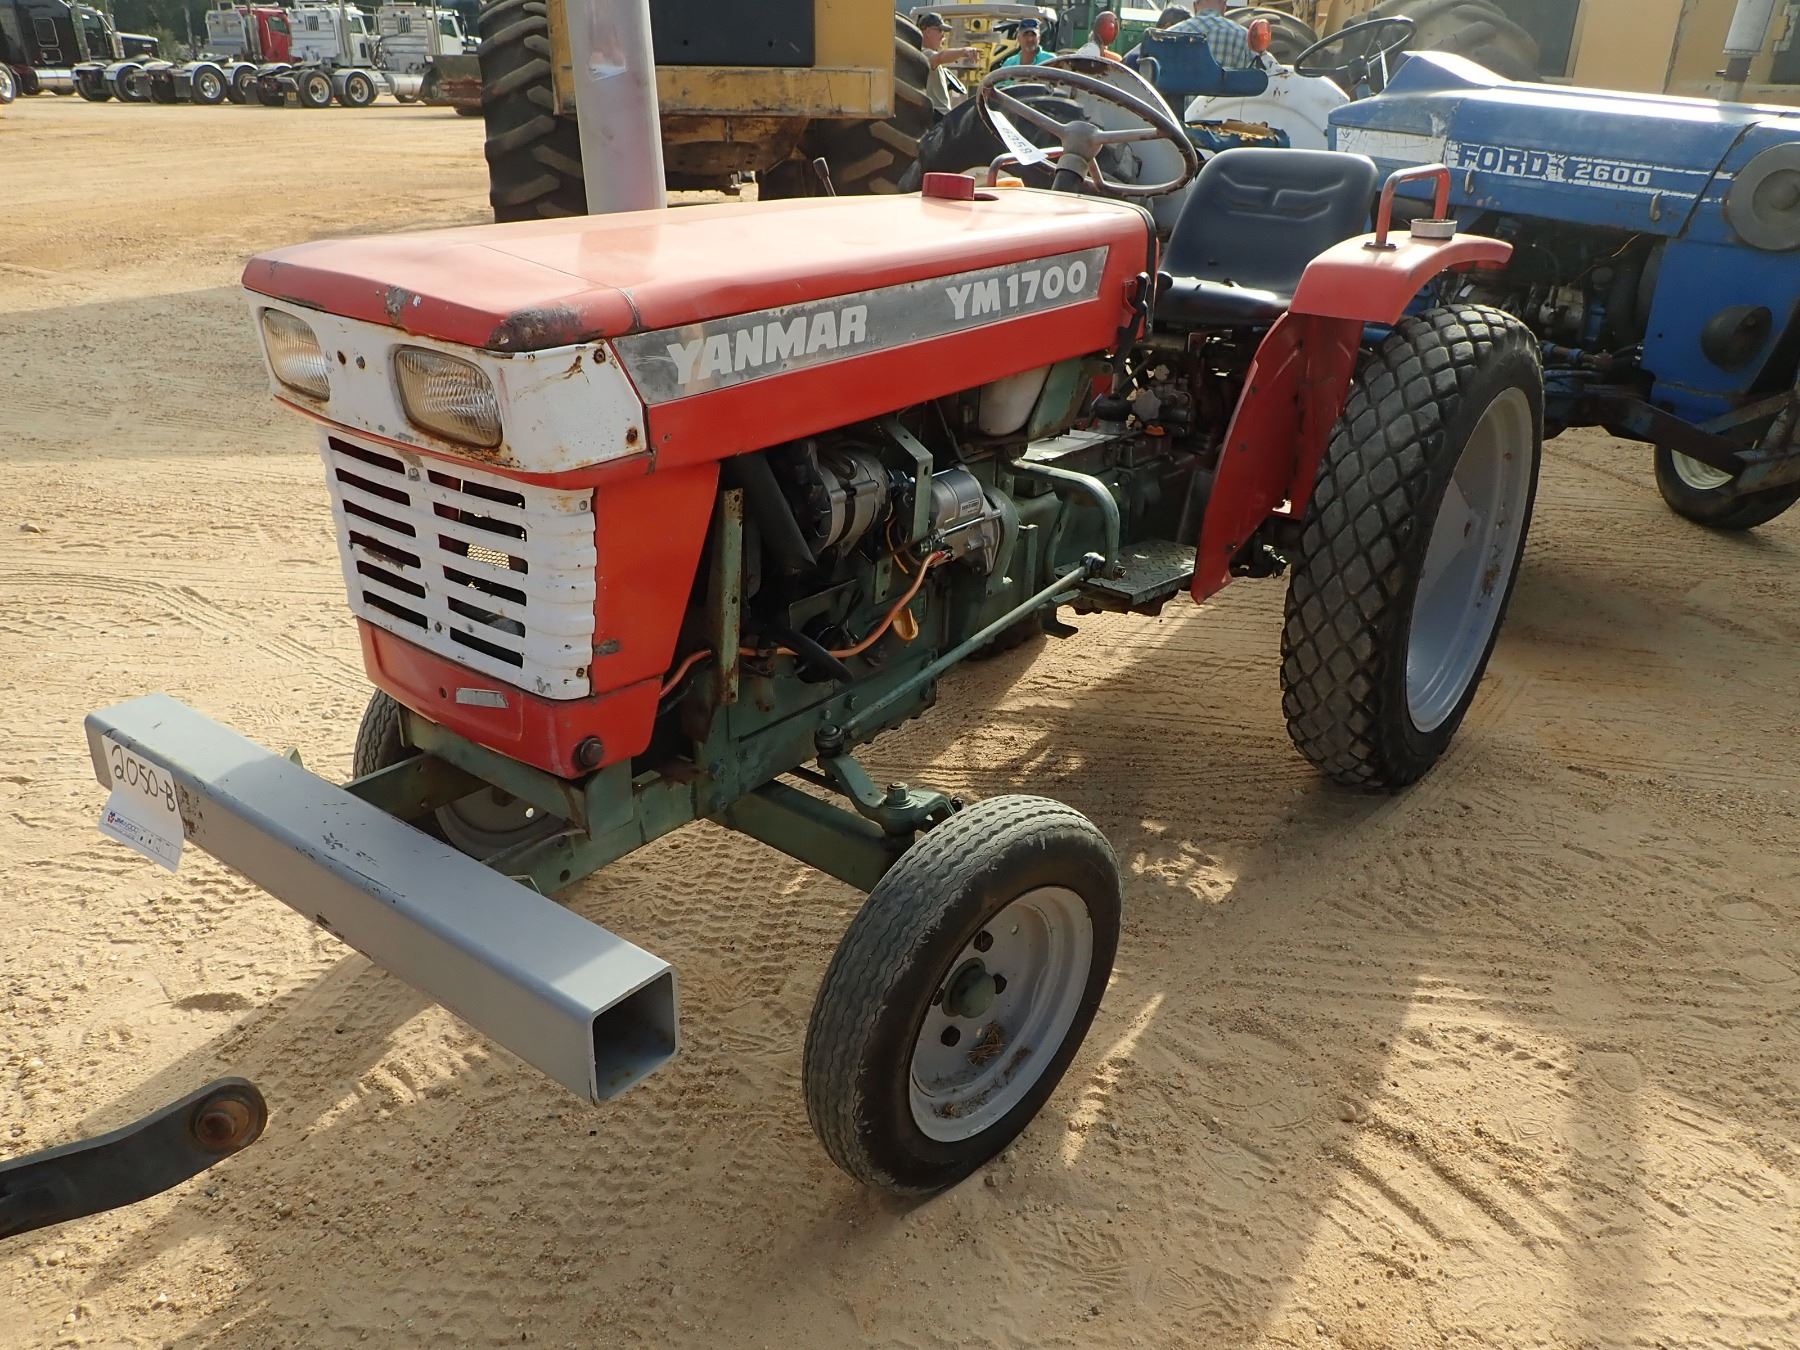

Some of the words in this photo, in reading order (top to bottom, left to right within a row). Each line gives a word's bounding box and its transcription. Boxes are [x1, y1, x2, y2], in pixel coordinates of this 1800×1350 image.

[1456, 144, 1550, 177] FORD
[1574, 162, 1652, 185] 2600
[667, 305, 868, 385] YANMAR
[945, 261, 1087, 320] YM1700
